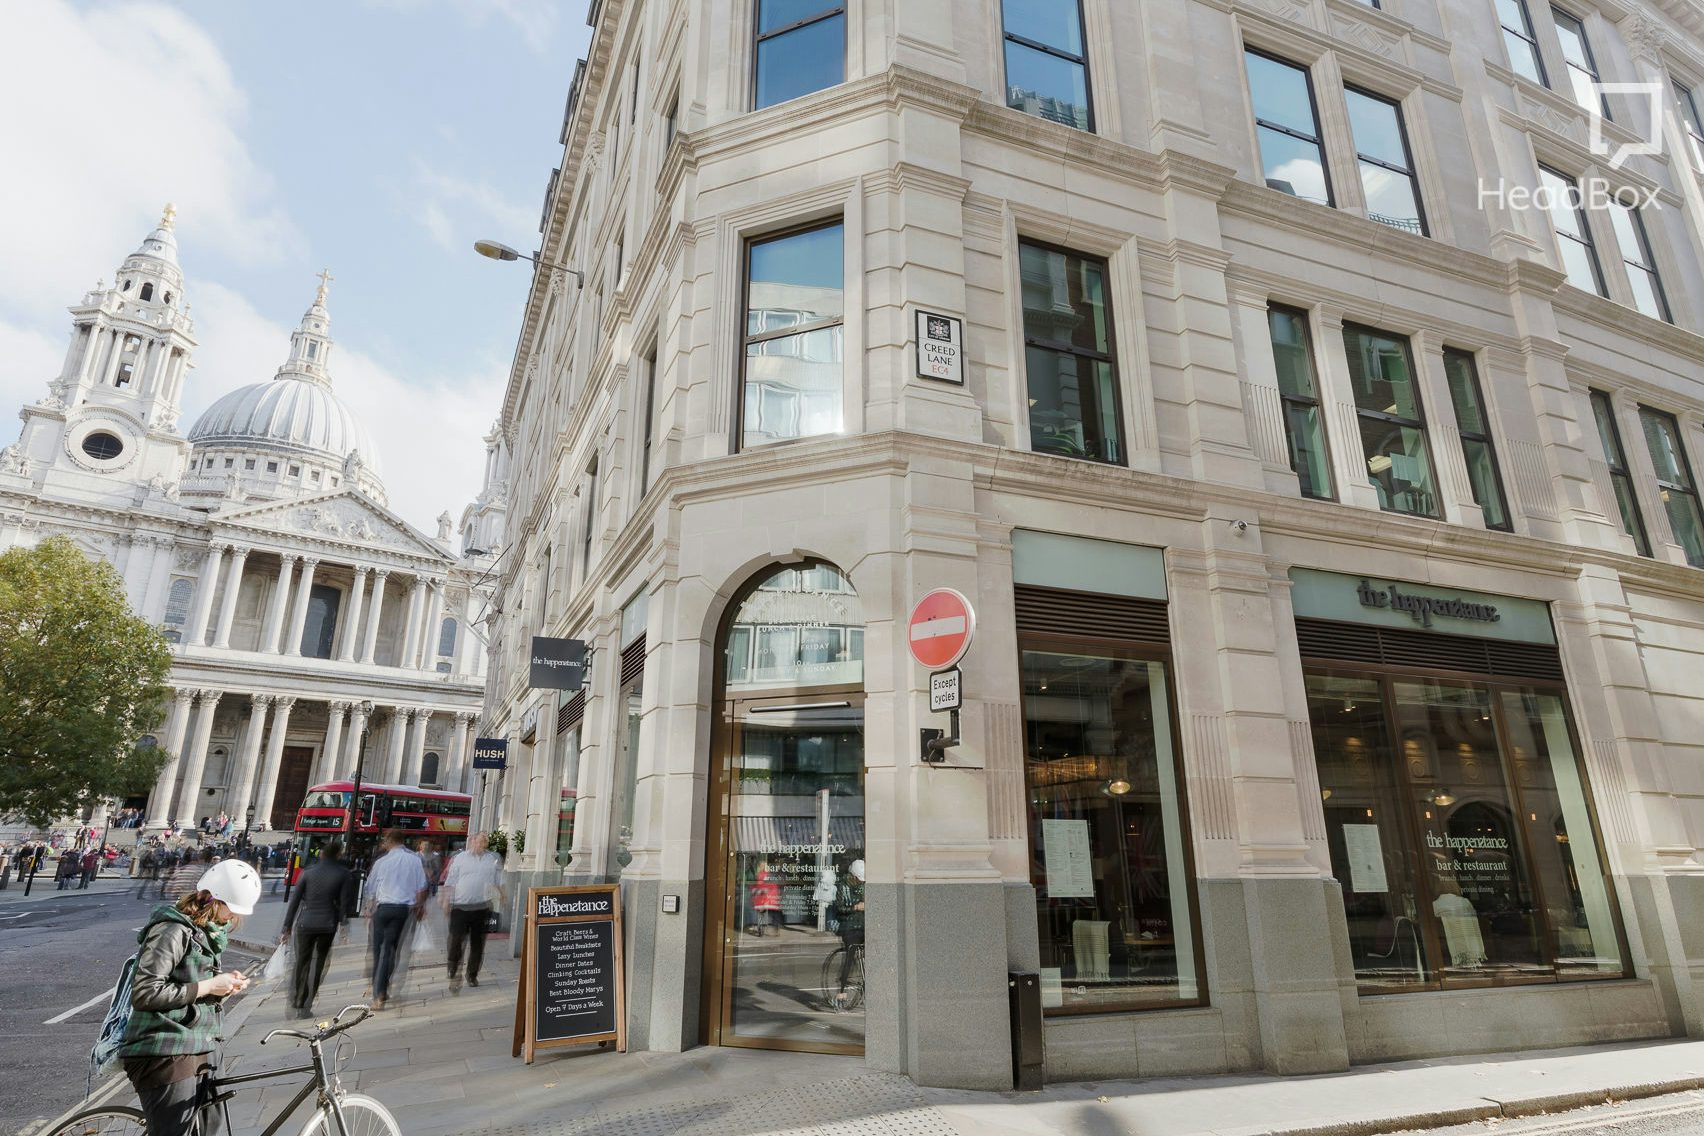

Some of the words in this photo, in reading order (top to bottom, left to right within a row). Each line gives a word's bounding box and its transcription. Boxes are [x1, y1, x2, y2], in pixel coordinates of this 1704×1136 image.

[924, 343, 956, 356] CREED
[927, 353, 953, 366] LANE
[932, 364, 949, 375] EC4
[1357, 579, 1388, 608] the
[1387, 584, 1501, 627] happenstance
[532, 656, 543, 665] the
[933, 677, 957, 690] Except
[934, 691, 955, 704] cycles
[475, 749, 505, 759] HUSH
[332, 817, 341, 826] 15
[1426, 830, 1444, 848] the
[1444, 832, 1509, 856] happenstance
[764, 863, 781, 873] bar
[782, 863, 790, 873] &
[1436, 859, 1452, 871] bar
[1454, 860, 1462, 871] &
[1463, 861, 1508, 871] restaurant
[541, 895, 557, 906] the
[538, 900, 609, 916] happenstance
[574, 968, 601, 976] Cocktails
[554, 979, 578, 987] Sunday
[563, 988, 584, 996] Bloody
[585, 986, 604, 994] Marys
[545, 1006, 561, 1014] Open
[568, 1003, 582, 1011] Days
